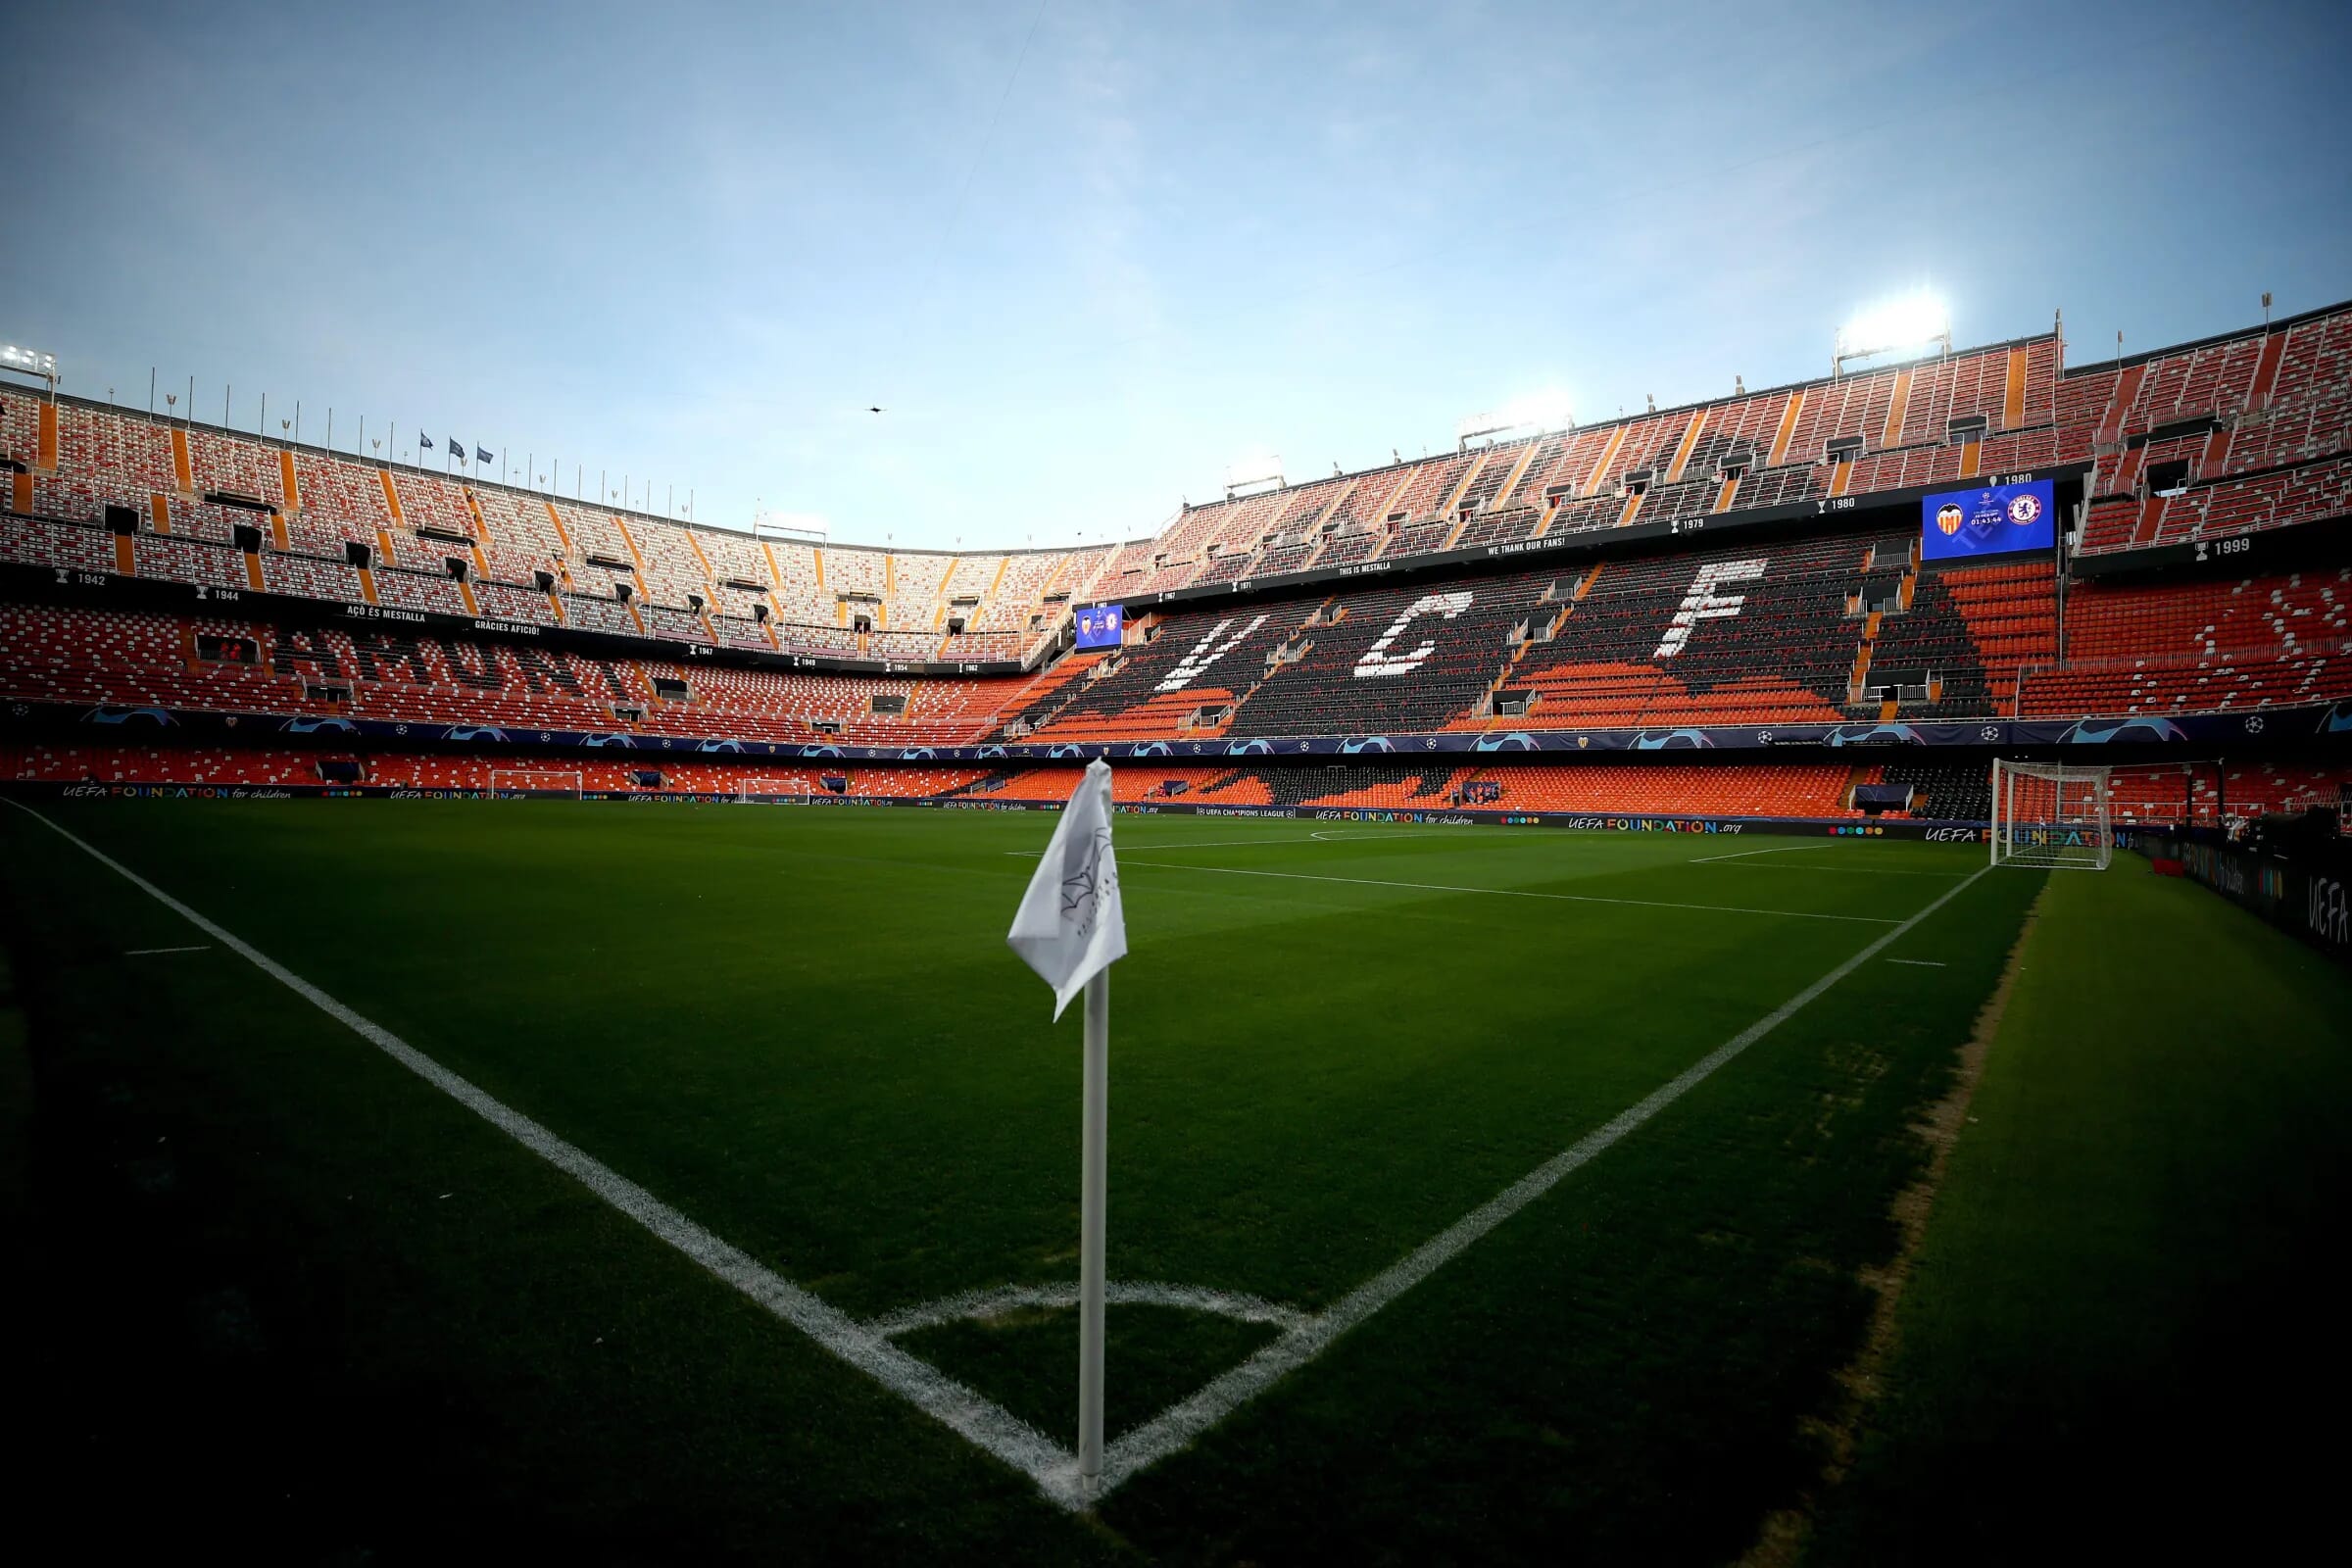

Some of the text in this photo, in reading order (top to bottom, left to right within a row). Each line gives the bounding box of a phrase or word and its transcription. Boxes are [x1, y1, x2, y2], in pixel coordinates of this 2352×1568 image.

[1831, 498, 1855, 511] 1980
[1683, 518, 1704, 530] 1979
[1488, 537, 1565, 556] WE THANK OUR FANS!
[2214, 538, 2250, 556] 1999
[1339, 567, 1352, 576] THIS
[1361, 562, 1391, 573] MESTALLA
[77, 573, 106, 586] 1942
[215, 590, 239, 601] 1944
[368, 606, 380, 617] ÉS
[383, 610, 425, 622] MESTALLA
[1354, 592, 1474, 678] C
[1653, 560, 1767, 660] F
[474, 619, 540, 636] GRÀCIES AFICIÓ!
[63, 785, 291, 800] UEFA FOUNDATION for children
[390, 790, 422, 800] UEFA
[1315, 809, 1474, 825] UEFA FOUNDATION for children
[1568, 817, 1741, 834] UEFA FOUNDATION .org
[1925, 828, 1977, 843] UEFA
[2309, 875, 2349, 944] UEFA
